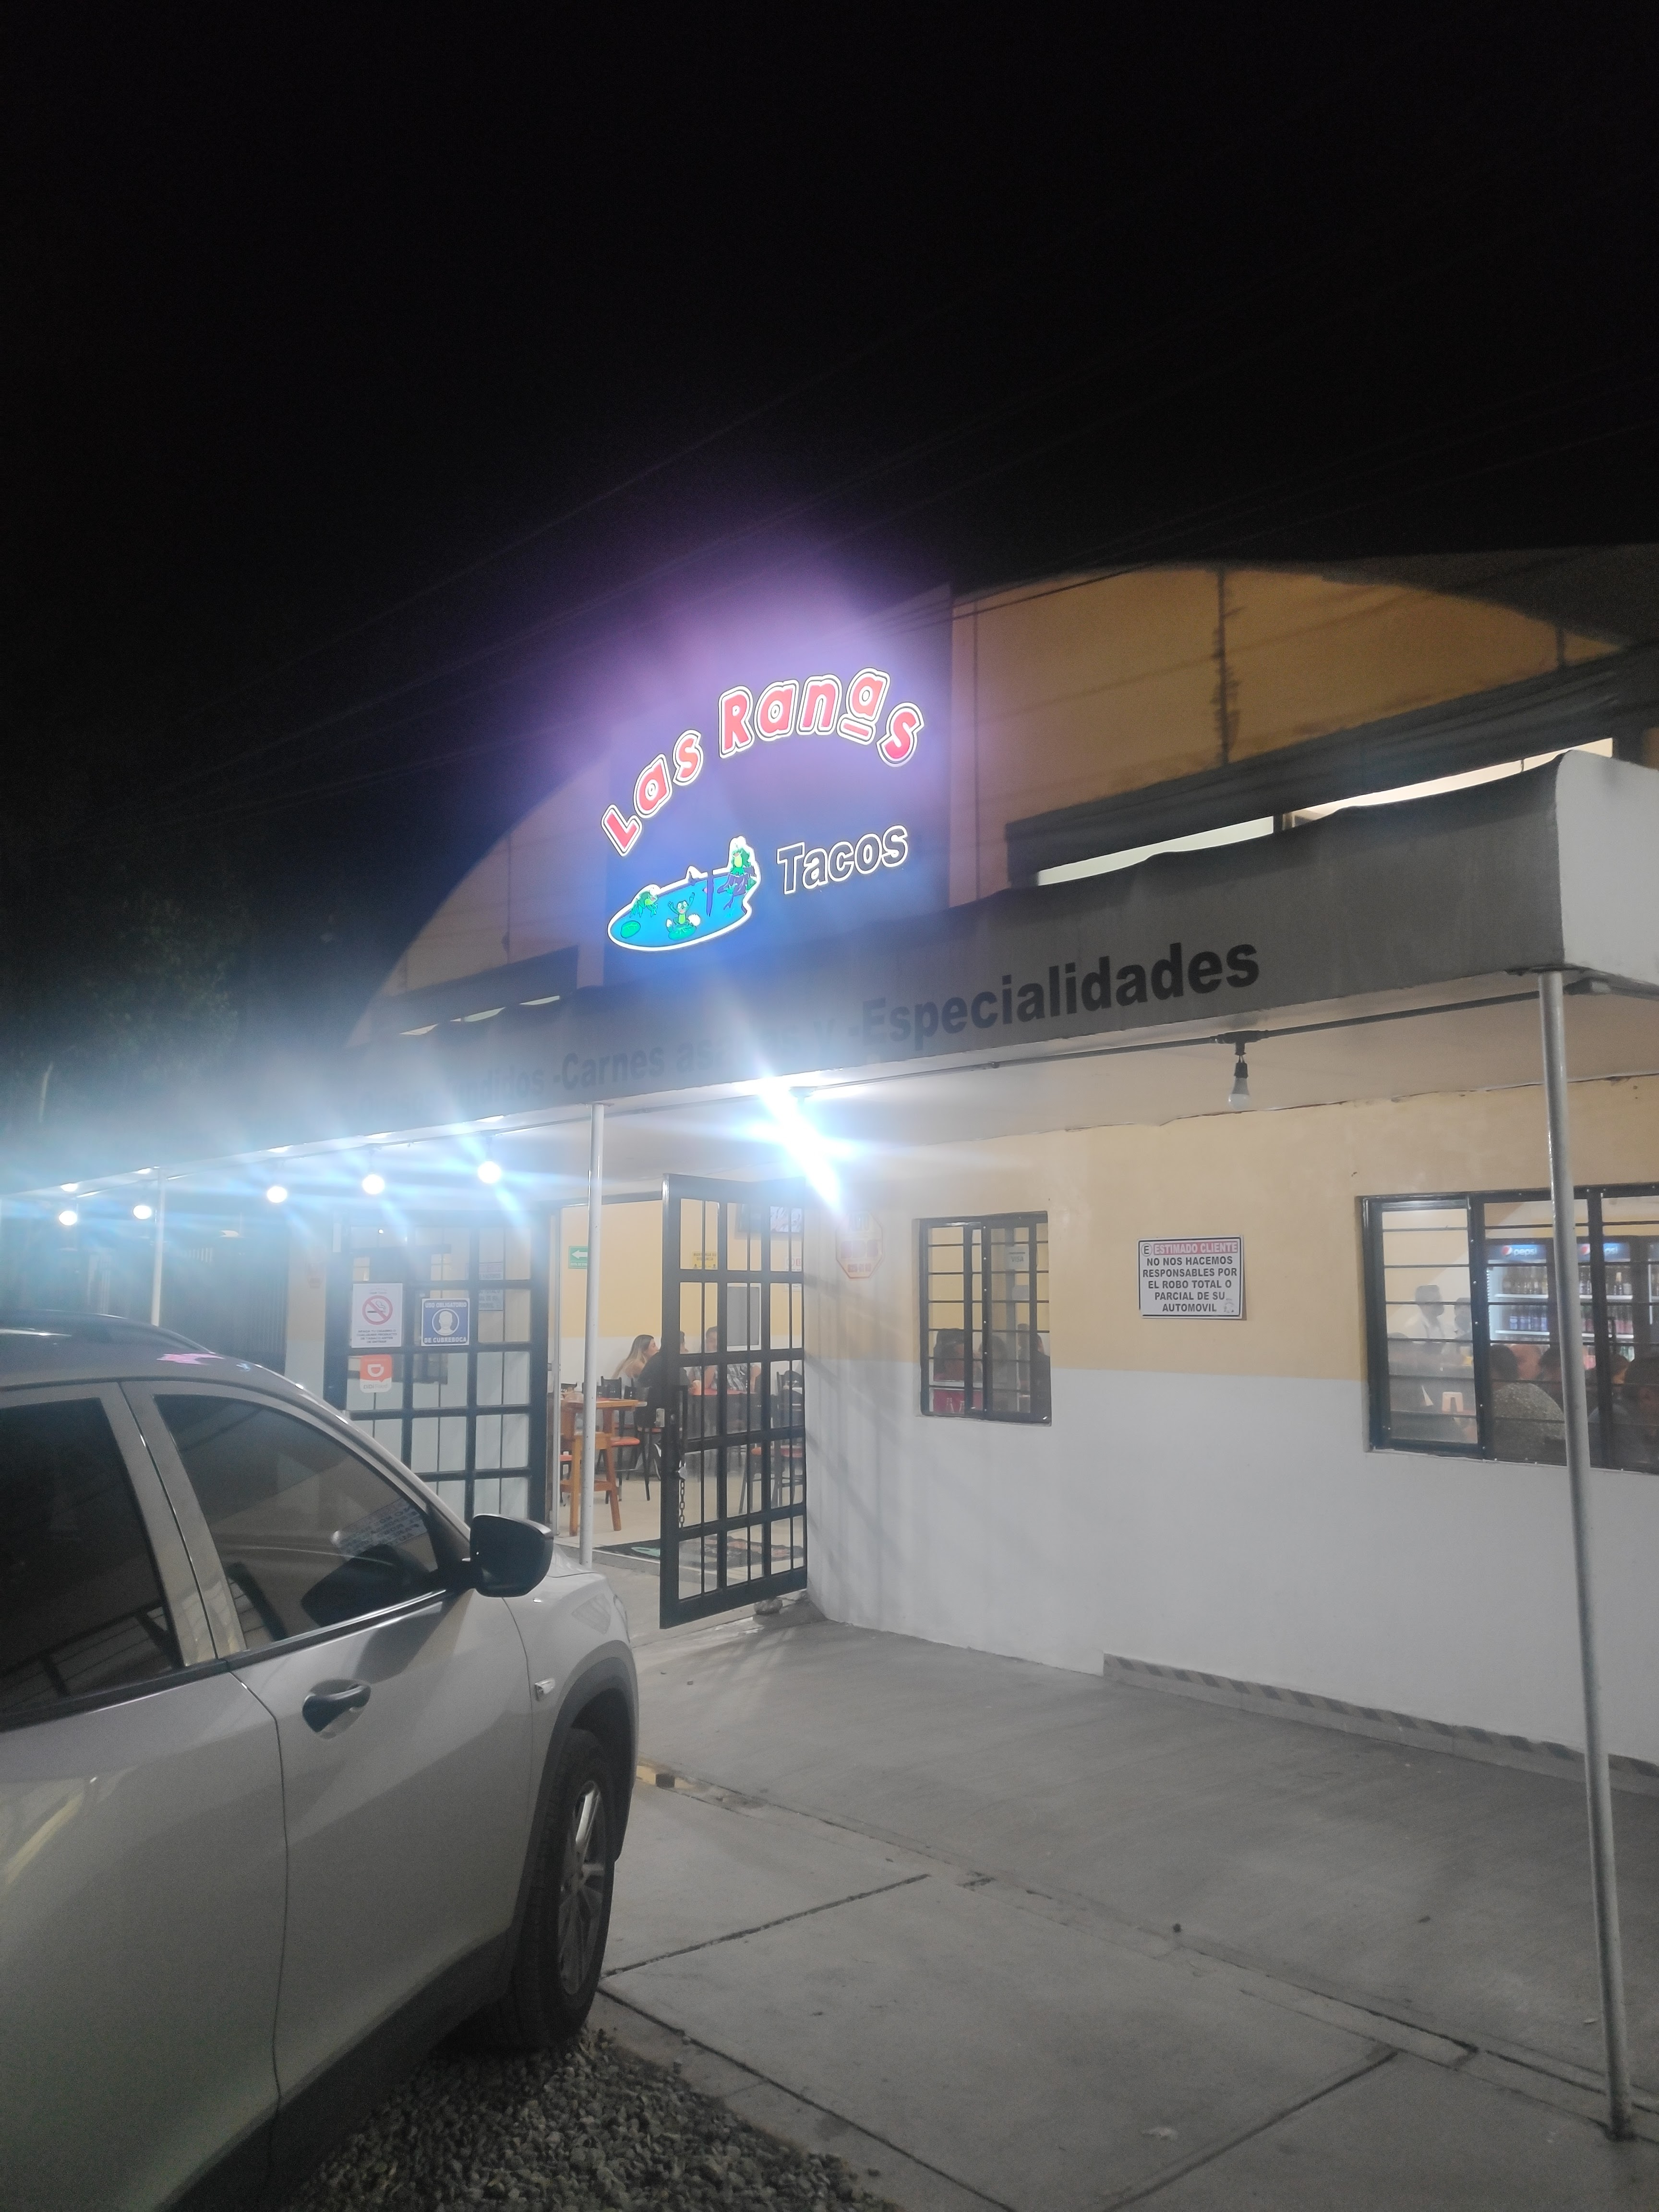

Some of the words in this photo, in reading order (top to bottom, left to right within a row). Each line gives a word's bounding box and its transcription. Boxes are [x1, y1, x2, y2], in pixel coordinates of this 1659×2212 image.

[601, 731, 704, 856] Las
[720, 668, 924, 767] Ranas
[776, 825, 908, 895] Tacos
[1154, 1244, 1198, 1254] ESTIMADO
[1200, 1242, 1238, 1253] CLIENTE
[1514, 1247, 1537, 1256] pepsi
[1147, 1258, 1160, 1266] NO
[1163, 1257, 1182, 1265] NOS
[1186, 1256, 1233, 1265] HACEMOS
[1143, 1268, 1214, 1277] RESPONSABLES
[1218, 1268, 1237, 1276] POR
[1162, 1280, 1189, 1288] ROBO
[1192, 1280, 1222, 1288] TOTAL
[1225, 1280, 1232, 1288] O
[1197, 1292, 1209, 1300] DE
[1213, 1292, 1225, 1300] SU
